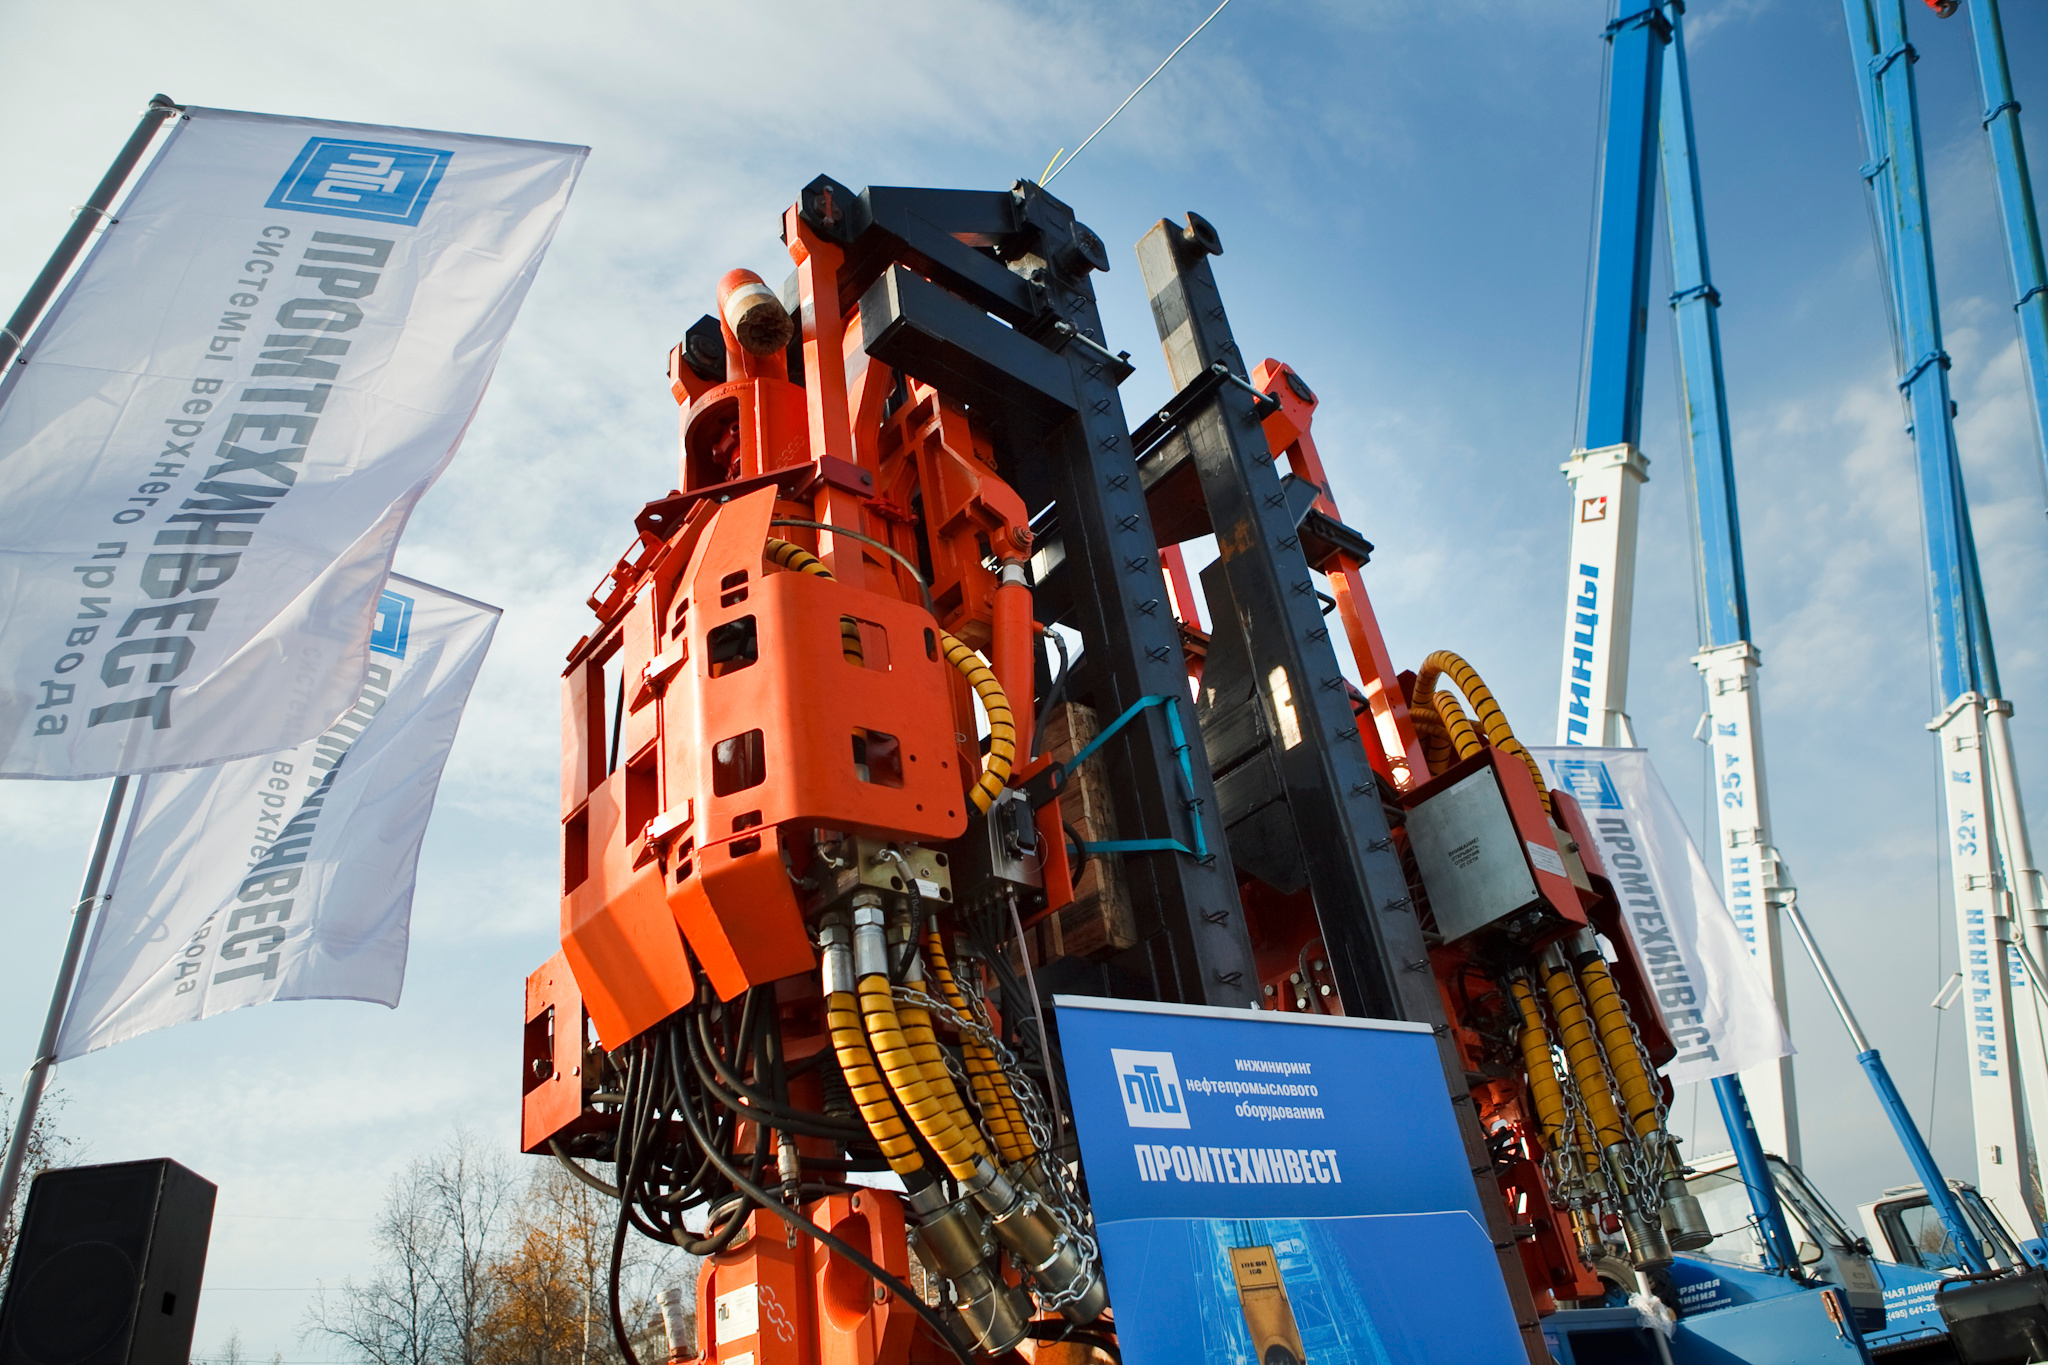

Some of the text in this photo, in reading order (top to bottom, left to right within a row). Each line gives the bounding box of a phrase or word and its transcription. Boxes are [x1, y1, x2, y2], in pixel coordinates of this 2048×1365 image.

[34, 225, 291, 737] системы верхнего привода
[88, 230, 395, 731] ПРОМТЕХИНВЕСТ
[1466, 856, 1479, 866] СЕТИ
[1597, 818, 1721, 1064] ПРОМТЕХИНВЕСТ
[1966, 909, 1999, 1077] ГАЛИЧАНИН
[1235, 1059, 1312, 1077] инжиниринг
[1185, 1078, 1319, 1098] нефтепромыслового
[1235, 1102, 1325, 1121] оборудования
[1134, 1144, 1342, 1184] ПРОМТЕХИНВЕСТ
[1677, 1278, 1720, 1296] РЯЧАЯ
